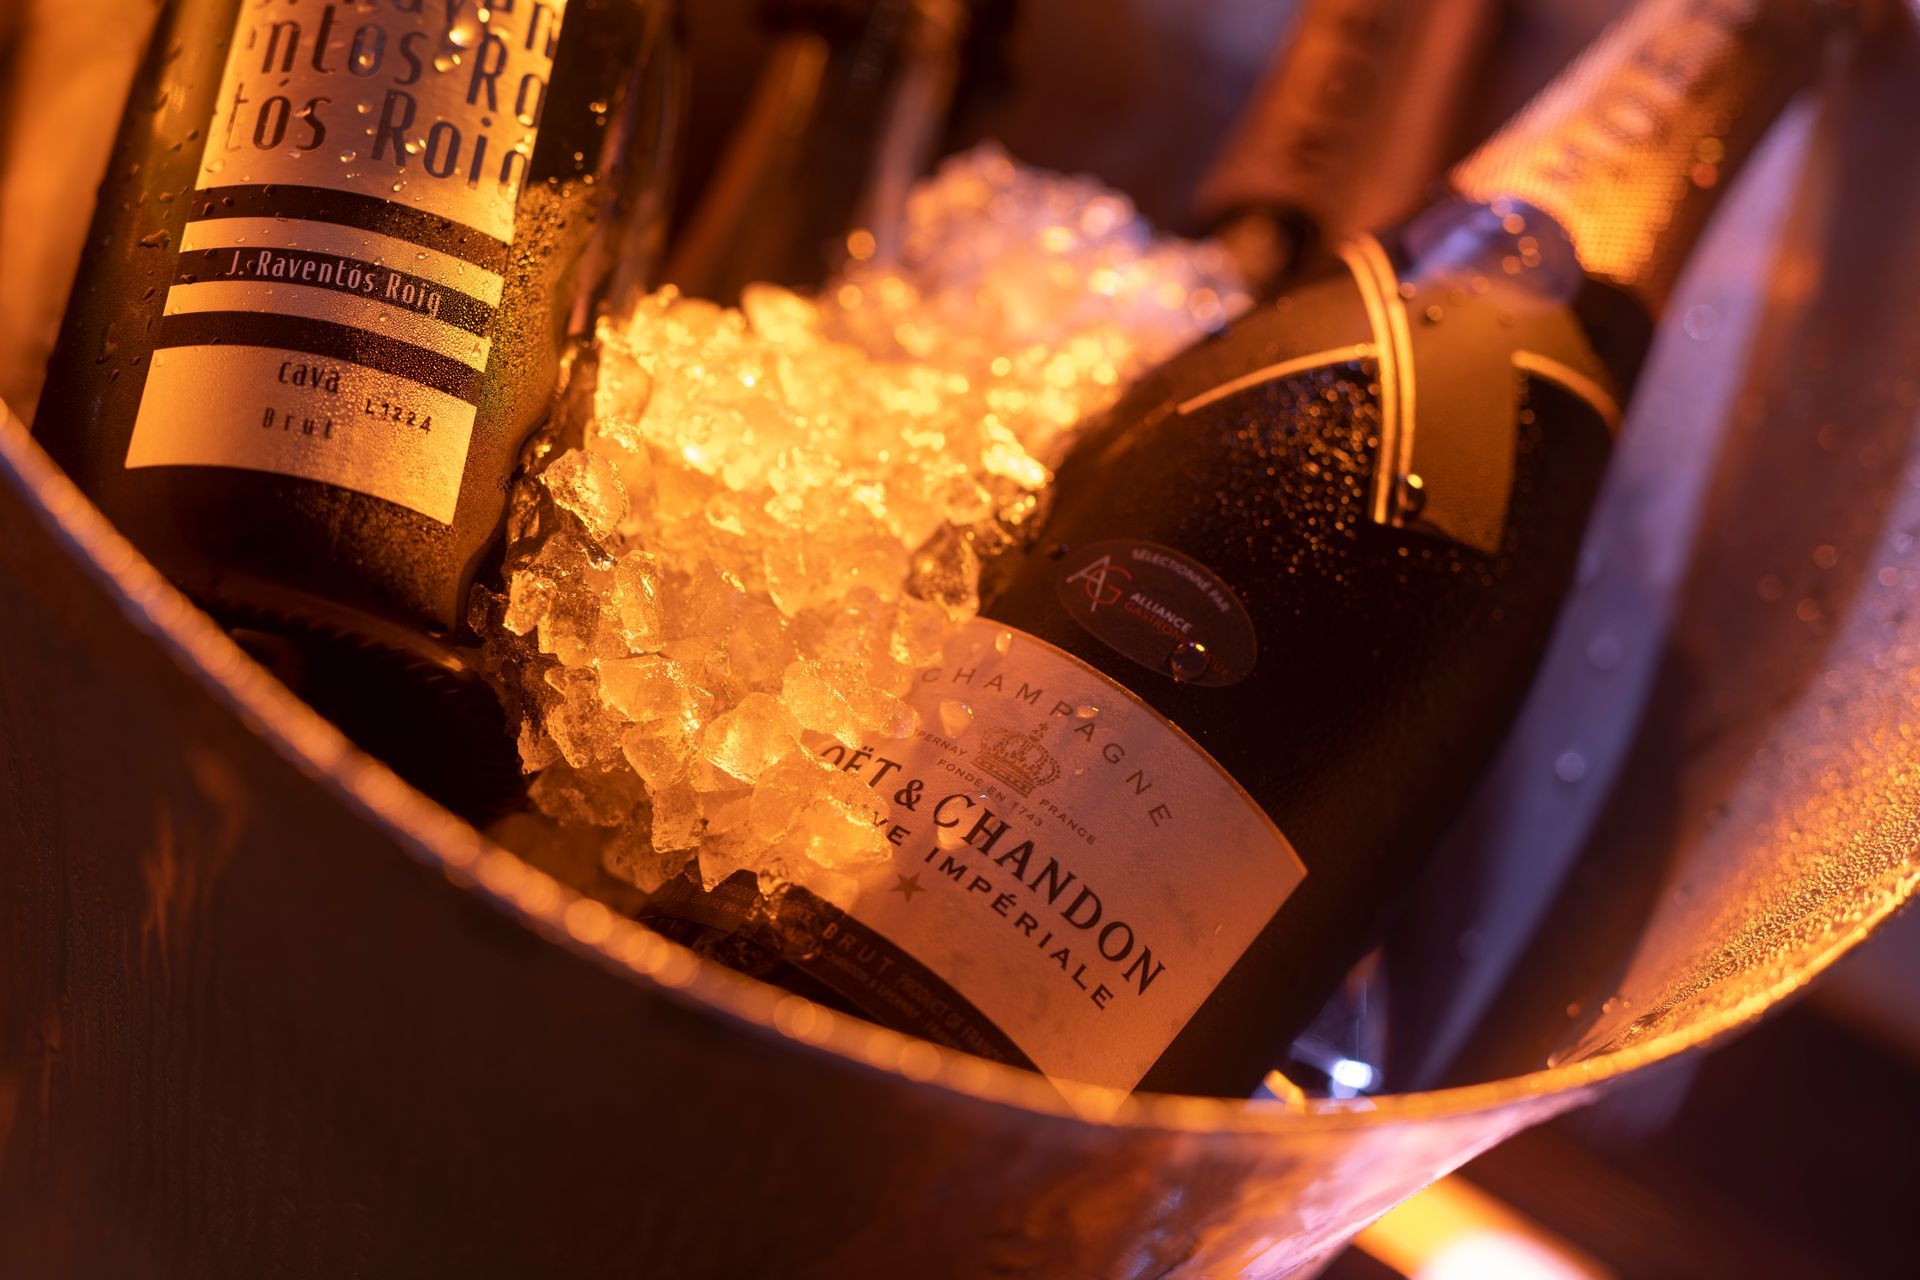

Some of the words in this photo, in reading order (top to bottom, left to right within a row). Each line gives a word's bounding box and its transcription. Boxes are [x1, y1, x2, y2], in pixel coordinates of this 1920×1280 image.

[226, 250, 245, 276] J.
[255, 250, 376, 293] Raventós
[385, 272, 442, 317] Roig
[278, 361, 341, 393] cava
[262, 407, 333, 439] Brut
[364, 399, 432, 435] L1224
[1130, 592, 1193, 633] ALLIANCE
[921, 666, 1173, 828] CHAMPAGNE
[911, 728, 968, 758] PERNAY
[1039, 798, 1097, 845] FRANCE
[936, 758, 984, 788] FONDÉ
[986, 785, 1007, 801] EN
[1012, 802, 1044, 828] 1743
[820, 744, 903, 788] OËT
[893, 779, 924, 812] &
[933, 793, 1167, 997] CHANDON
[822, 922, 896, 974] BRUT
[925, 846, 1115, 1011] IMPÉRIALE
